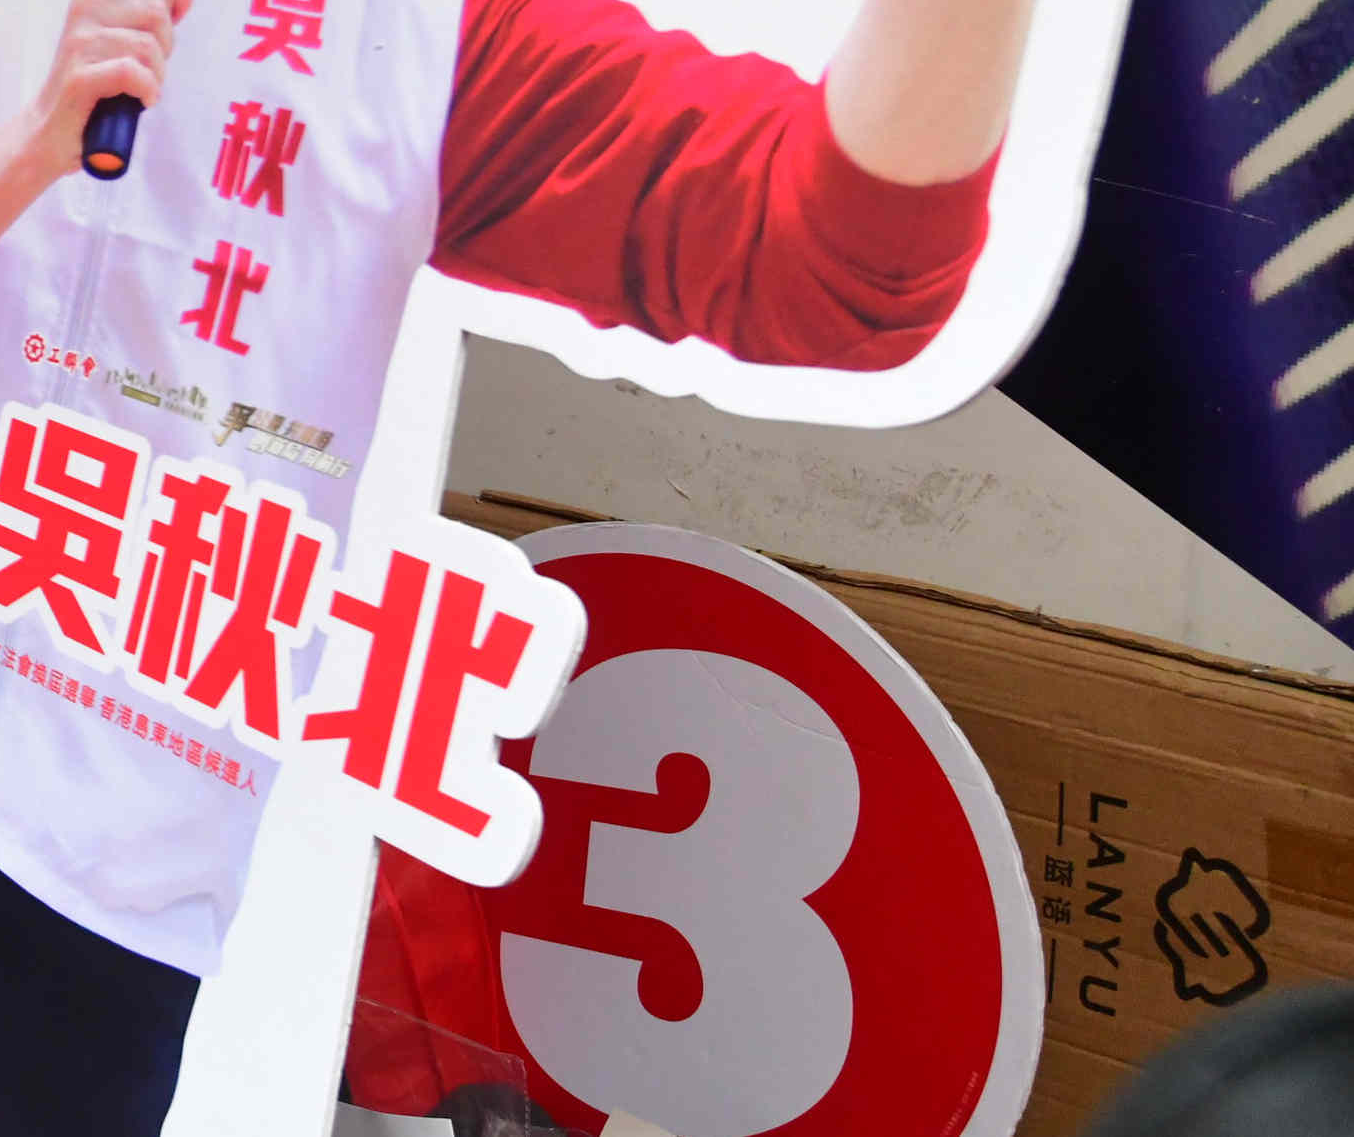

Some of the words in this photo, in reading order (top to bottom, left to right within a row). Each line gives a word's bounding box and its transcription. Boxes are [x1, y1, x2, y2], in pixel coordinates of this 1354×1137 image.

[499, 648, 861, 1137] 3
[1042, 855, 1075, 926] 蓝语
[1079, 792, 1128, 1019] LANYU
